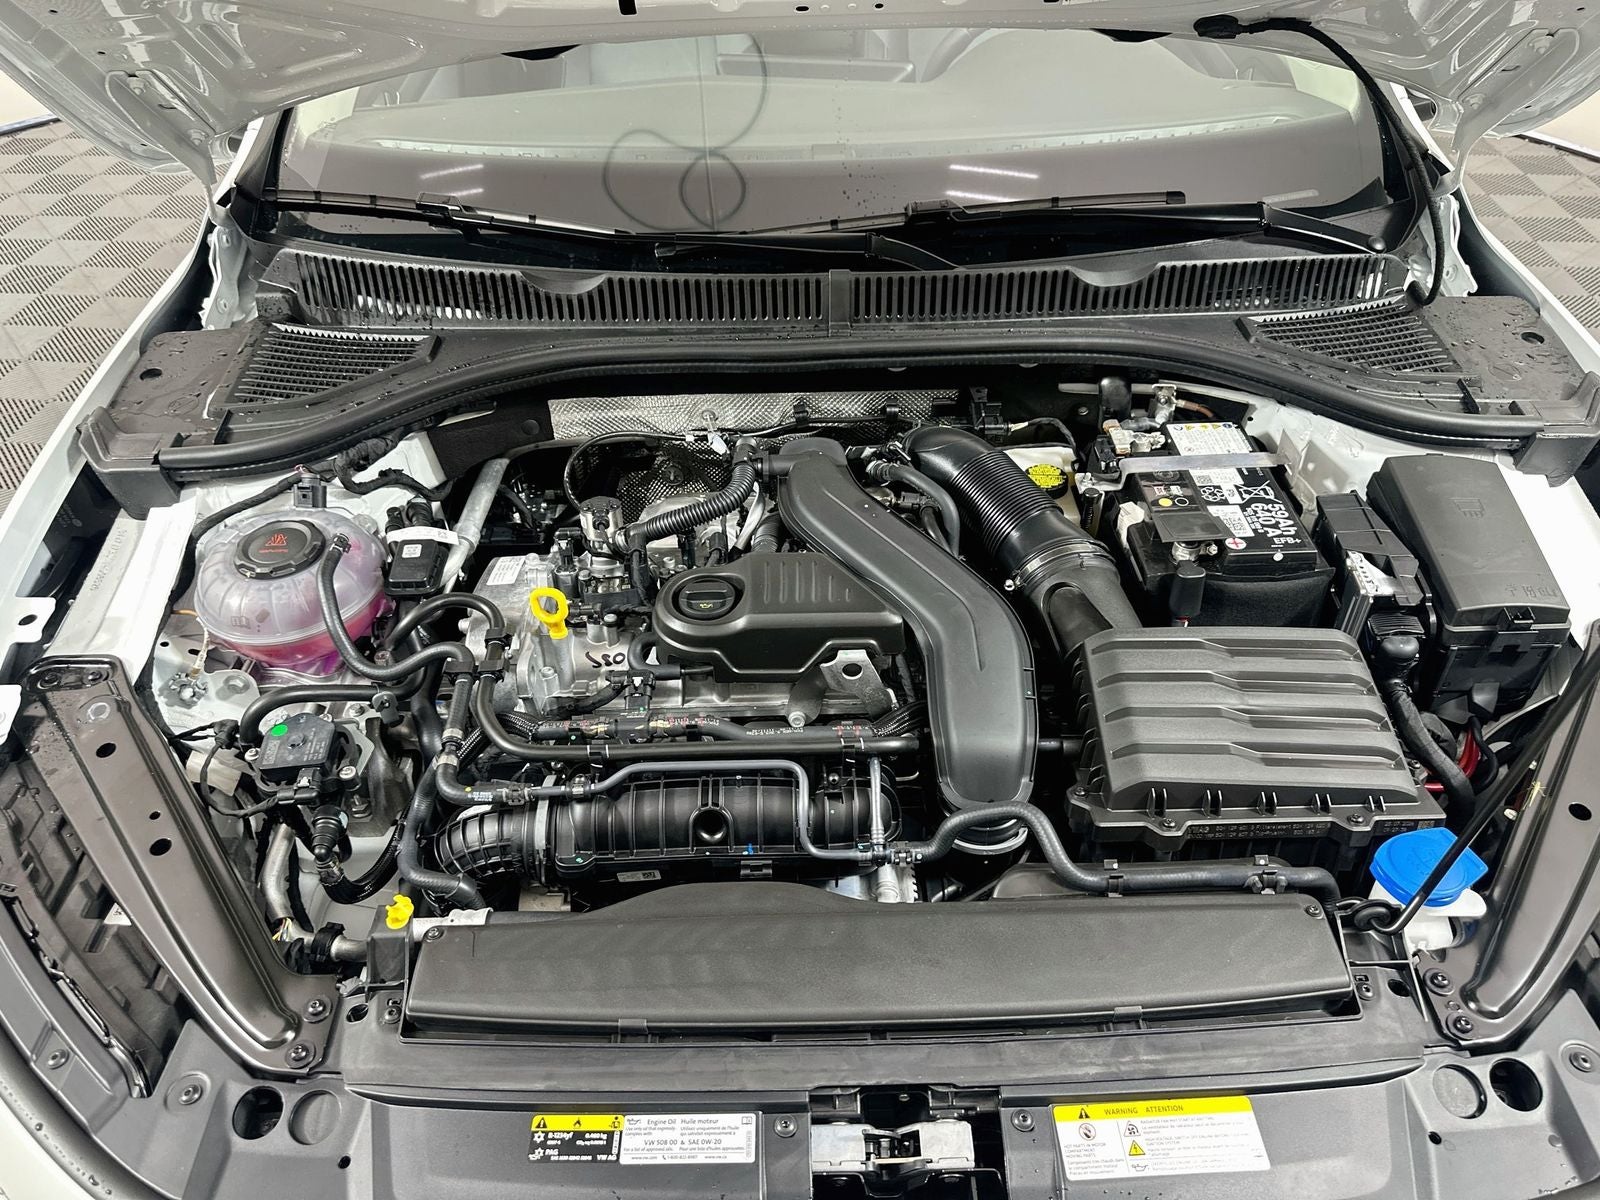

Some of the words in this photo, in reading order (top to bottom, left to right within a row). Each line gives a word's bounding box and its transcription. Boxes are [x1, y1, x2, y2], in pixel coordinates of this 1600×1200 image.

[1251, 503, 1276, 525] 640
[1264, 527, 1283, 537] A
[1268, 503, 1297, 535] 59Ah
[1104, 1107, 1138, 1115] WARNING
[1145, 1105, 1184, 1113] ATTENTION
[647, 1118, 667, 1126] Engine
